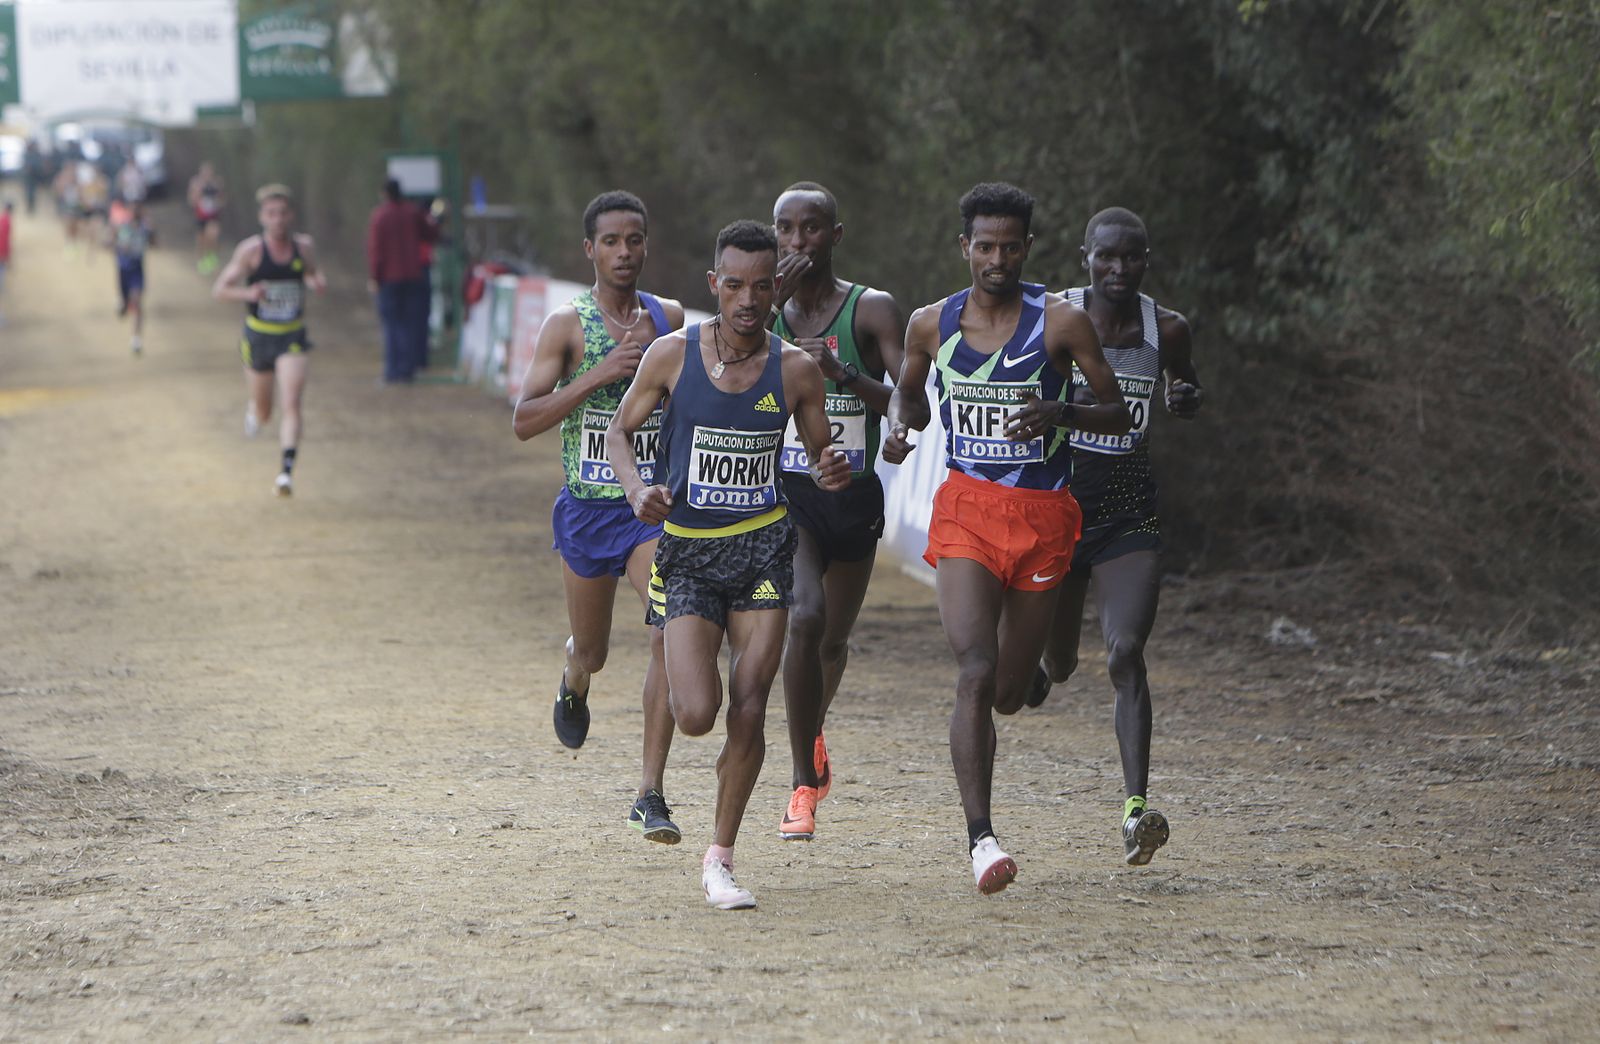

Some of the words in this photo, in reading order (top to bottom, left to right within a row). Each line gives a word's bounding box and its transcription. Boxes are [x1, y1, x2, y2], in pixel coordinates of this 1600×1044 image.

[952, 385, 996, 399] DIPUTACION
[998, 388, 1008, 400] DE
[754, 404, 780, 413] adidas
[825, 399, 834, 411] DE
[836, 399, 865, 412] SEVILLA
[695, 432, 744, 449] DIPUTACION
[745, 438, 755, 449] DE
[961, 440, 1030, 457] Joma
[698, 453, 772, 486] WORKU
[696, 488, 766, 505] Joma
[752, 592, 780, 600] adidas
